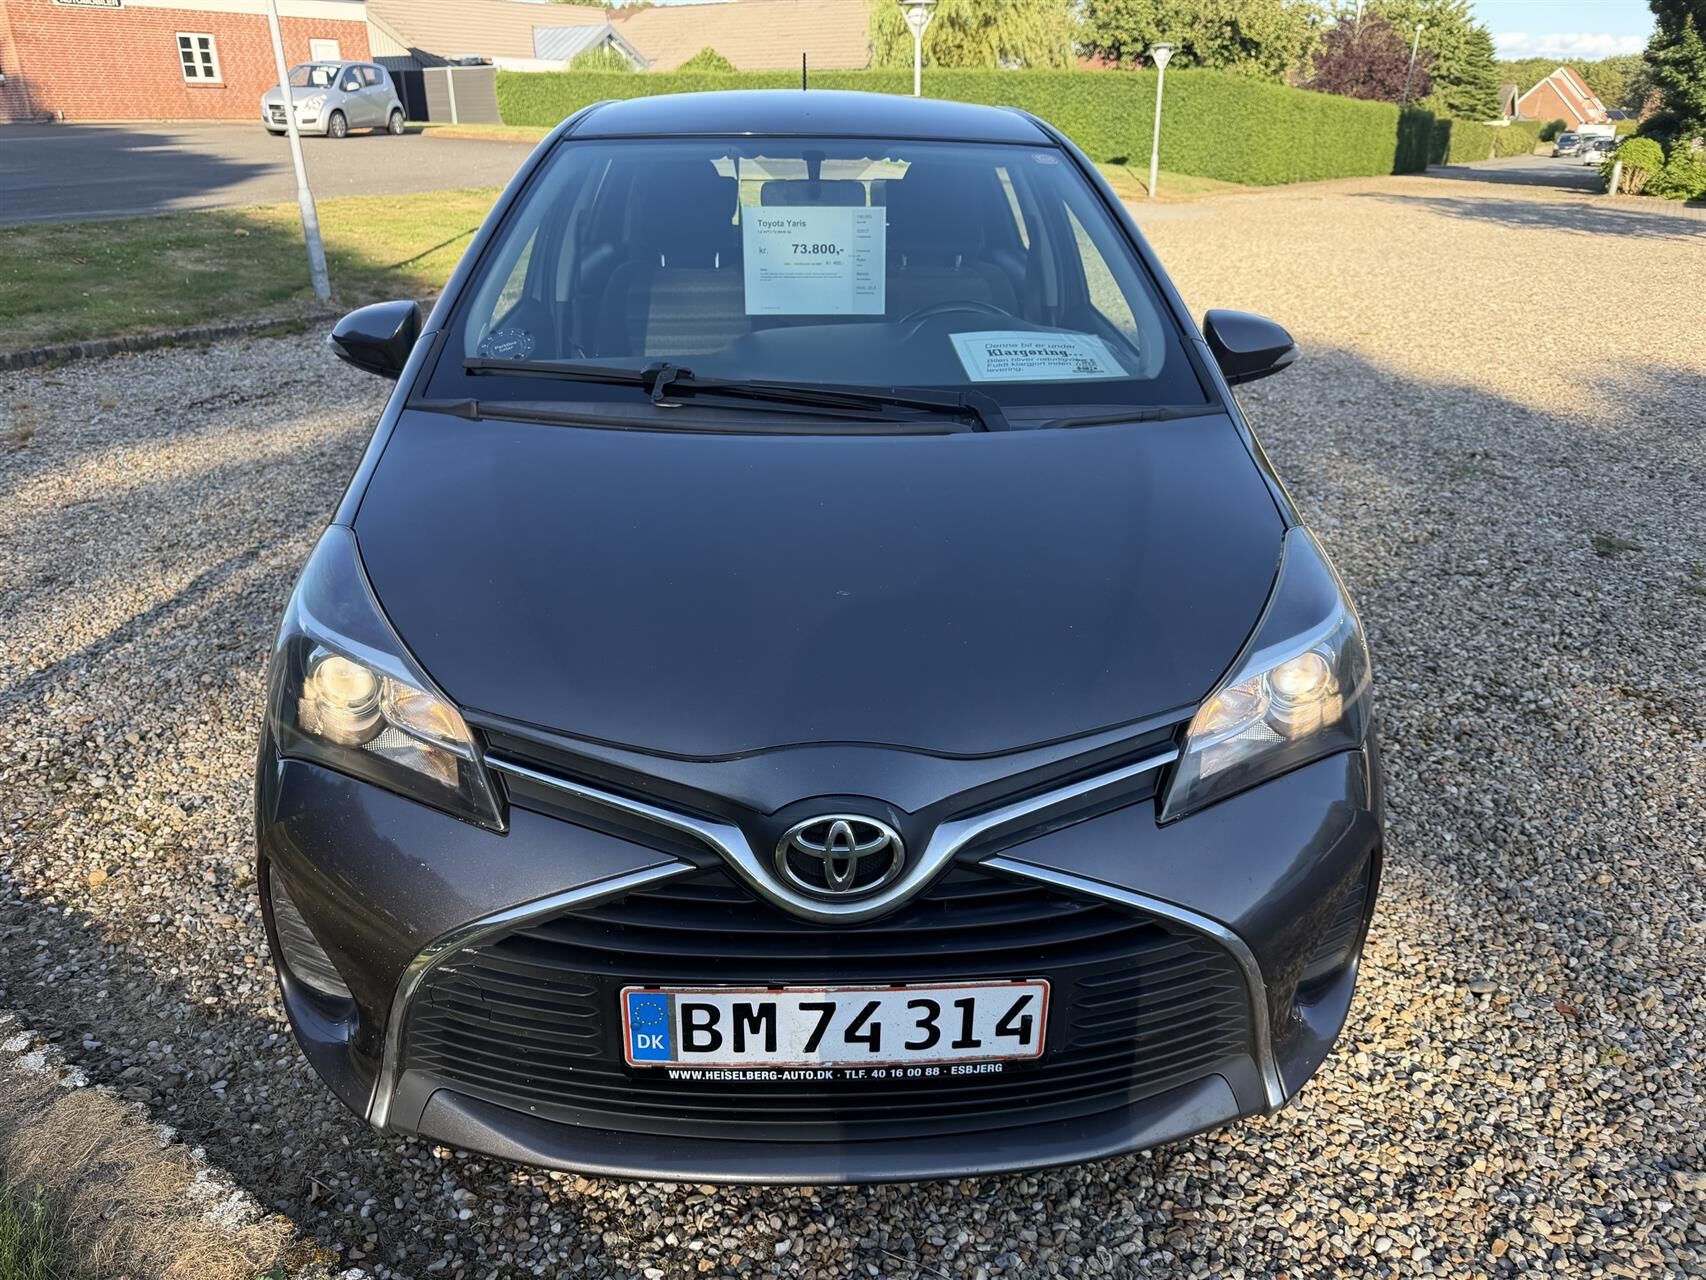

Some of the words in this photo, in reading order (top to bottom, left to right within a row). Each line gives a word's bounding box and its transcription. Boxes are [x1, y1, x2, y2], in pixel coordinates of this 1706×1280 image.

[757, 219, 784, 228] Toyota
[786, 219, 807, 227] Yaris
[792, 243, 844, 255] 73.800,-
[637, 1034, 664, 1049] DK
[680, 1002, 777, 1053] BM
[798, 1001, 881, 1053] 74
[904, 994, 1034, 1050] 314
[668, 1070, 834, 1081] WWW.HEISELBERG-AUTO.DK
[845, 1069, 868, 1079] TLF.
[871, 1069, 886, 1078] 40
[890, 1069, 903, 1077] 16
[907, 1068, 922, 1077] 00
[925, 1067, 940, 1076] 88
[951, 1063, 1003, 1075] ESBJERG
